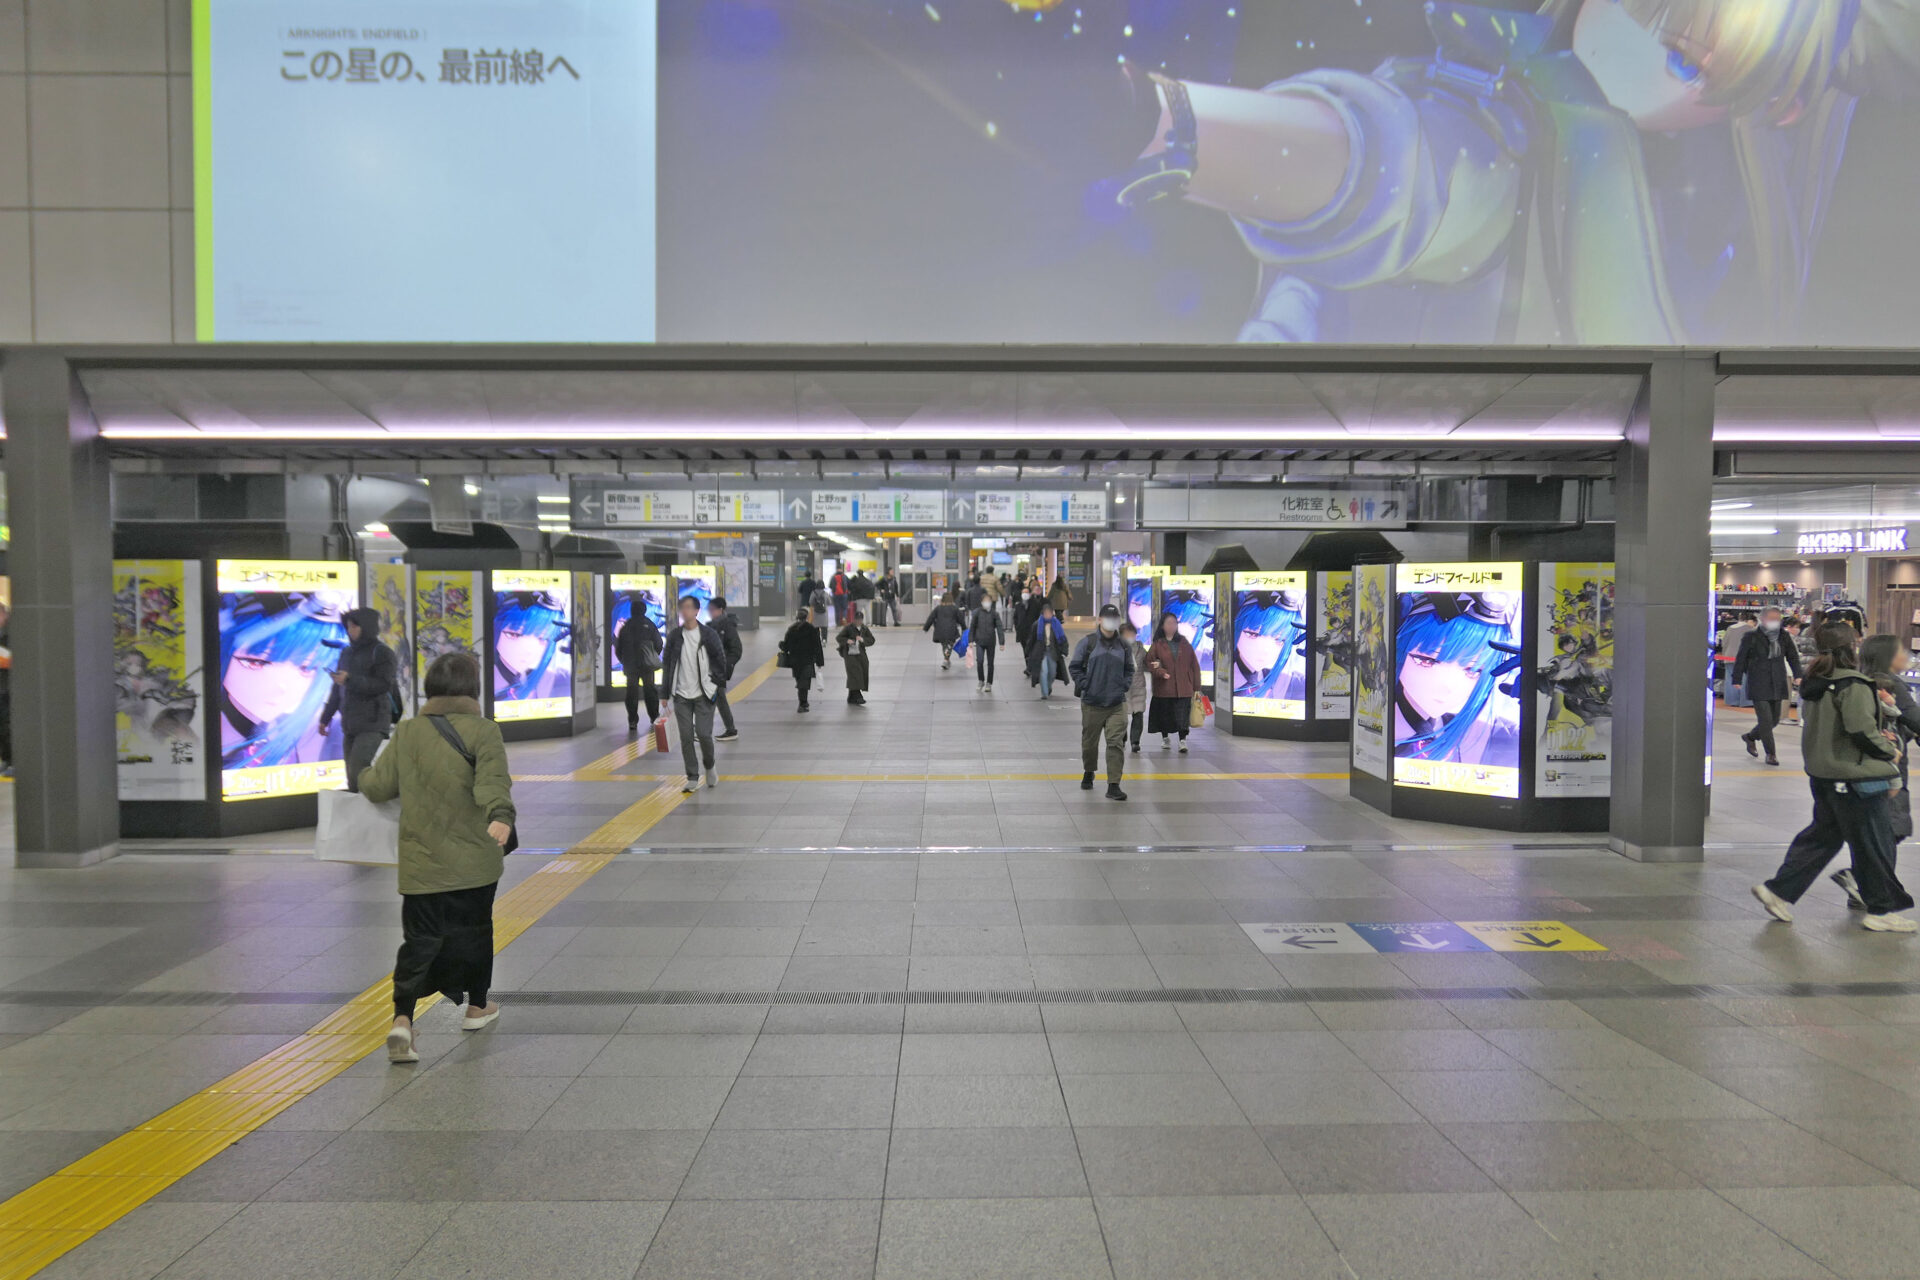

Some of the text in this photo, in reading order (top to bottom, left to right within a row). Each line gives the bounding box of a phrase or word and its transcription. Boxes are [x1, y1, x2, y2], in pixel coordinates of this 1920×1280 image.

[362, 28, 419, 39] ENDFIELD
[280, 47, 580, 85] この星の、最前線へ
[653, 492, 659, 502] 5
[743, 492, 750, 502] 6
[903, 493, 910, 502] 2
[1024, 492, 1031, 502] 3
[1070, 493, 1077, 503] 4
[1281, 496, 1324, 511] 化粧室
[1279, 513, 1323, 521] Restrooms
[1797, 528, 1907, 554] AKIBA LINK
[239, 569, 327, 583] エンドフィールド
[1413, 571, 1491, 585] エンドフィールド
